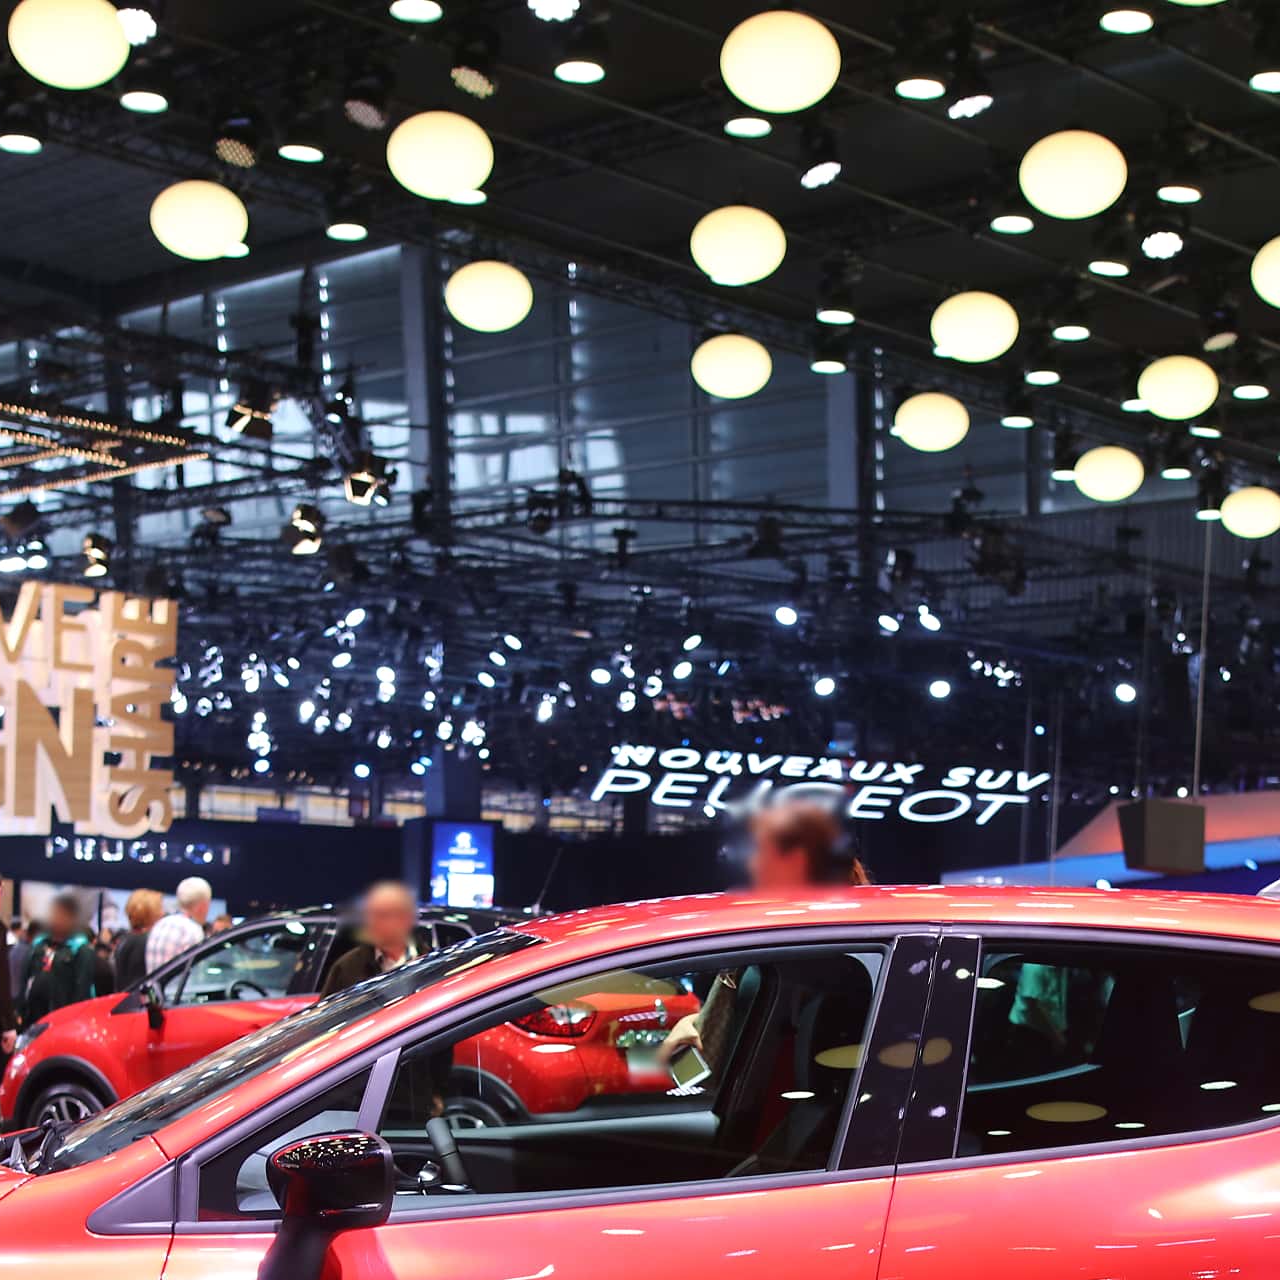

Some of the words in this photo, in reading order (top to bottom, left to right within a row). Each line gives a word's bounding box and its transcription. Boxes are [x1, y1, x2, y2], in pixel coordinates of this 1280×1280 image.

[100, 590, 178, 839] SHARE
[611, 745, 925, 784] NOUVEAUX
[941, 766, 1051, 793] SUV
